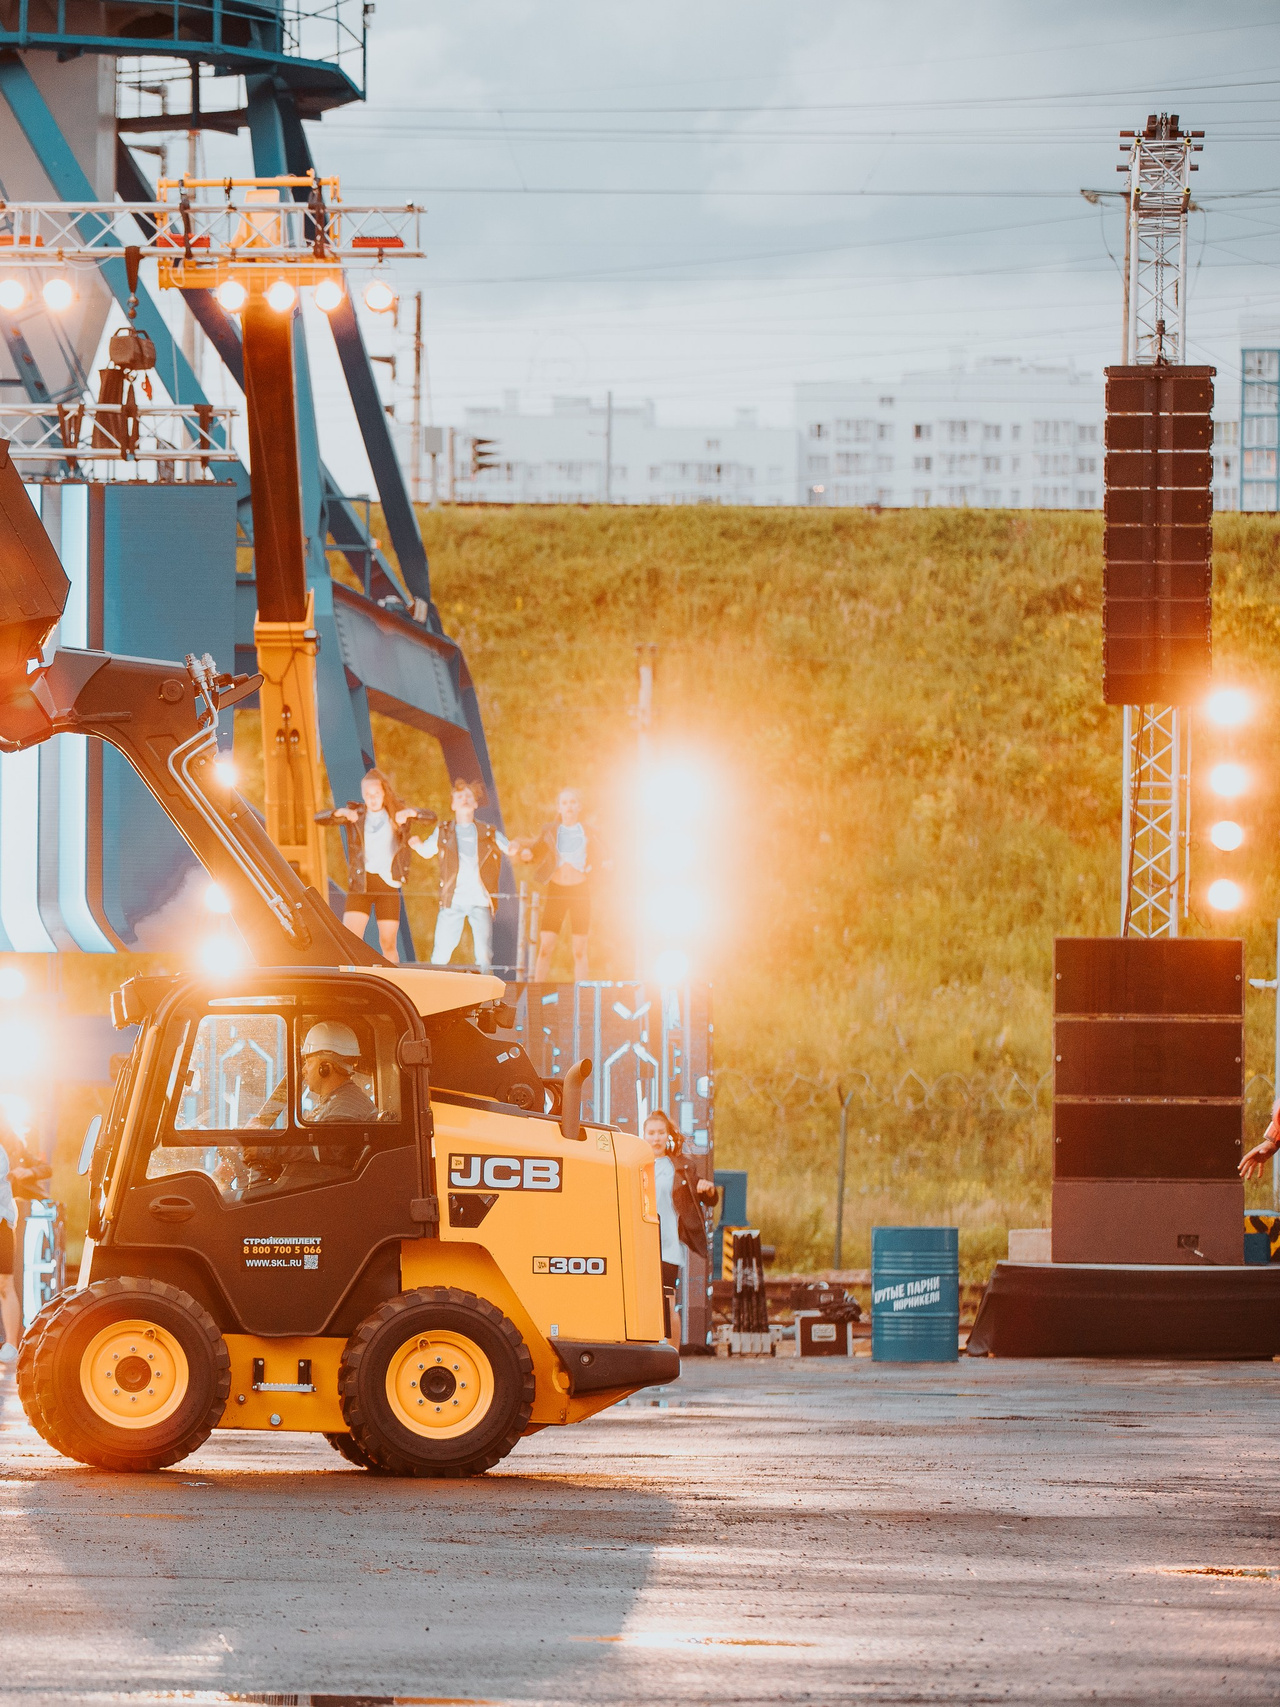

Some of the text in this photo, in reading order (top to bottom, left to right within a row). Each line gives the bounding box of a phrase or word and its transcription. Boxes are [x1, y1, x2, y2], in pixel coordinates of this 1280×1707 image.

[450, 1156, 560, 1190] JCB
[243, 1236, 322, 1245] СТРОЙКОМПЛЕКТ
[243, 1246, 322, 1254] 8 800 700 5 066
[245, 1259, 302, 1267] WWW.SKL.RU
[549, 1257, 605, 1275] 300
[906, 1275, 940, 1297] ПАРНИ
